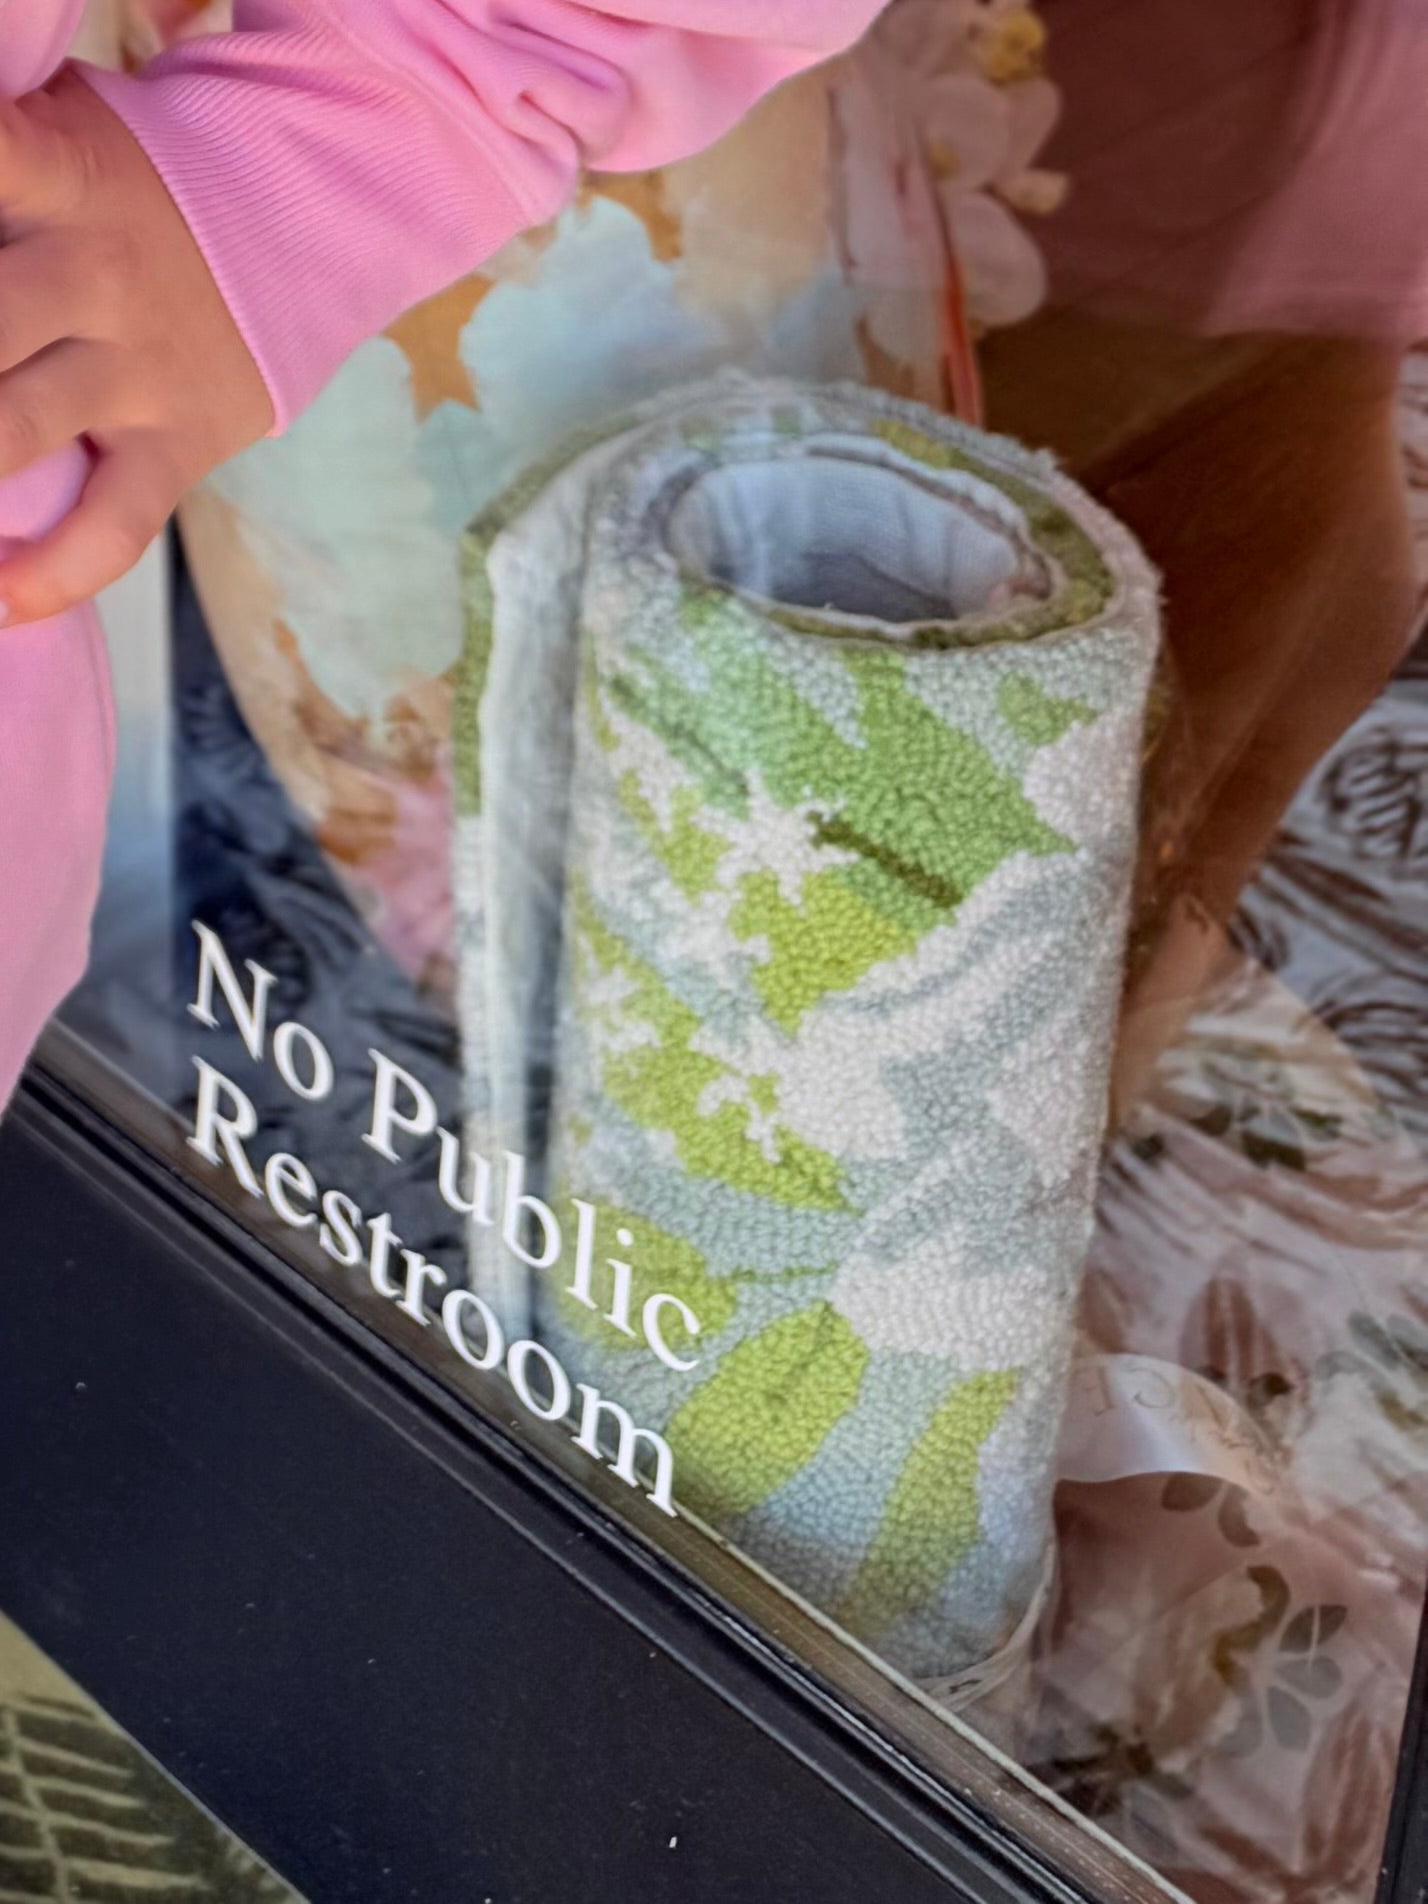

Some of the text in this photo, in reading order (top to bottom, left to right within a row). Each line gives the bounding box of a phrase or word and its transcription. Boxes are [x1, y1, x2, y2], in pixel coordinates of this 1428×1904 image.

[186, 1055, 679, 1518] Restroom
[187, 919, 701, 1371] No Public
